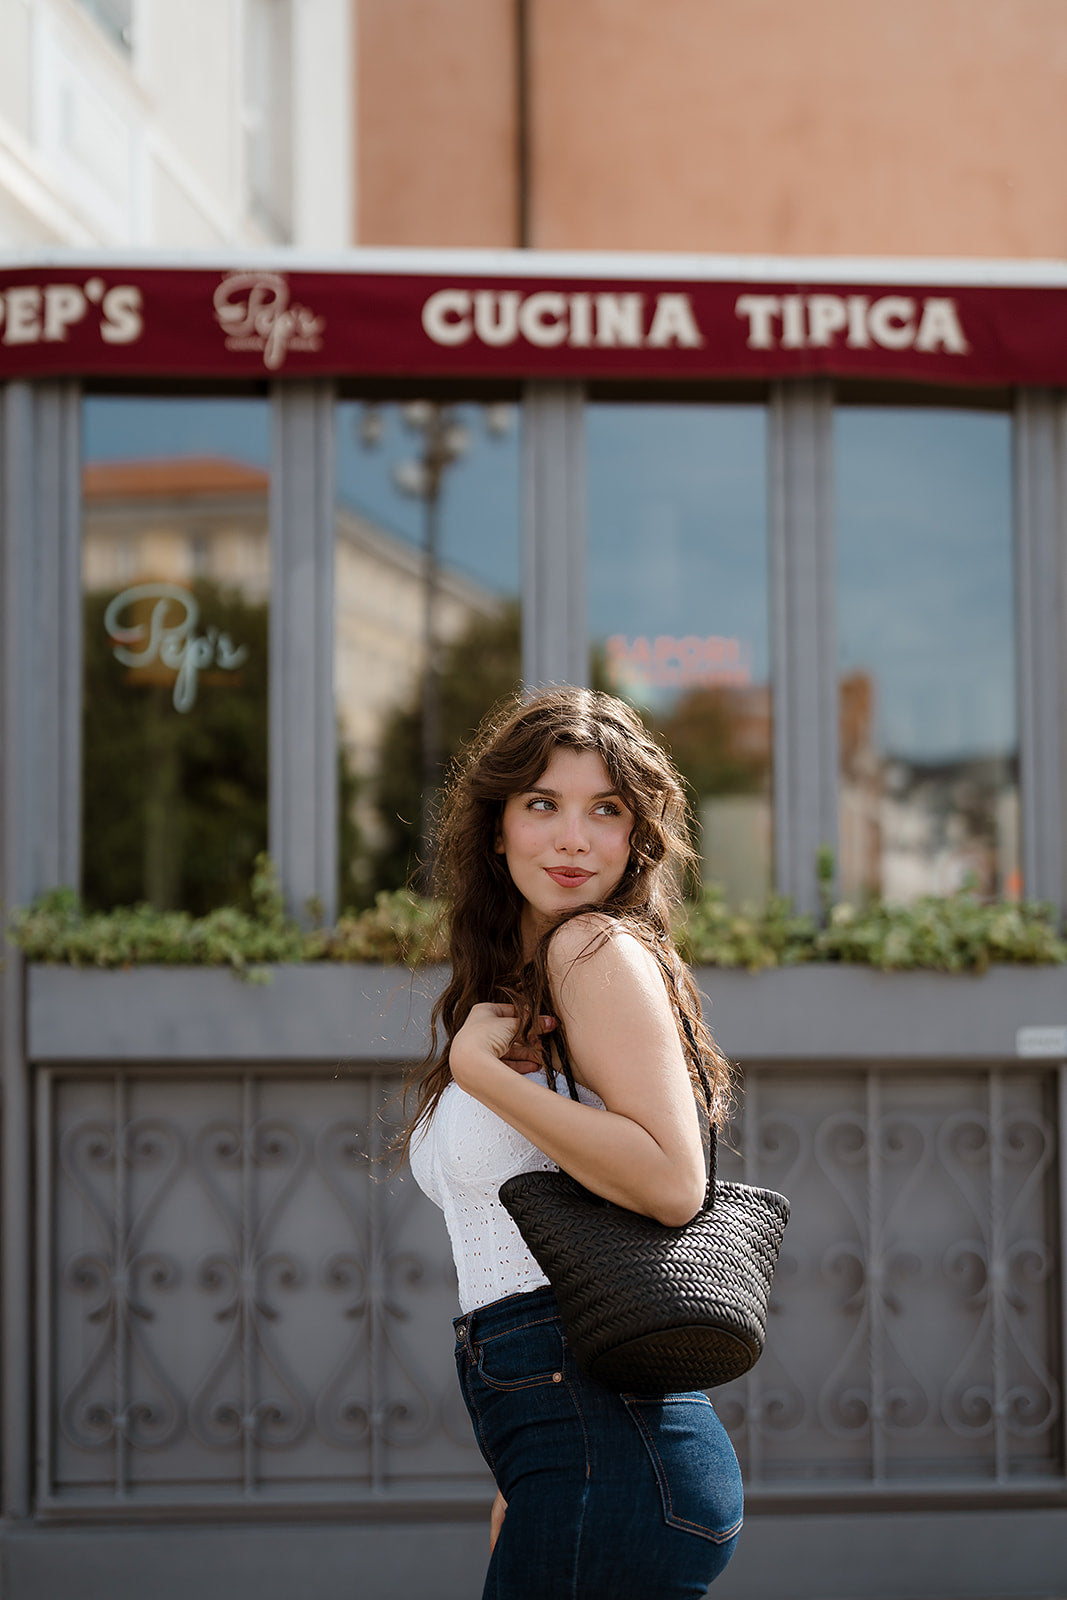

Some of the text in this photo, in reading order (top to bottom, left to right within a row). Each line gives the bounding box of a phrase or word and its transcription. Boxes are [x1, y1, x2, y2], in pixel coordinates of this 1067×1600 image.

[0, 278, 143, 345] EP'S
[422, 290, 968, 355] CUCINA TIPICA
[104, 583, 248, 713] Pep's
